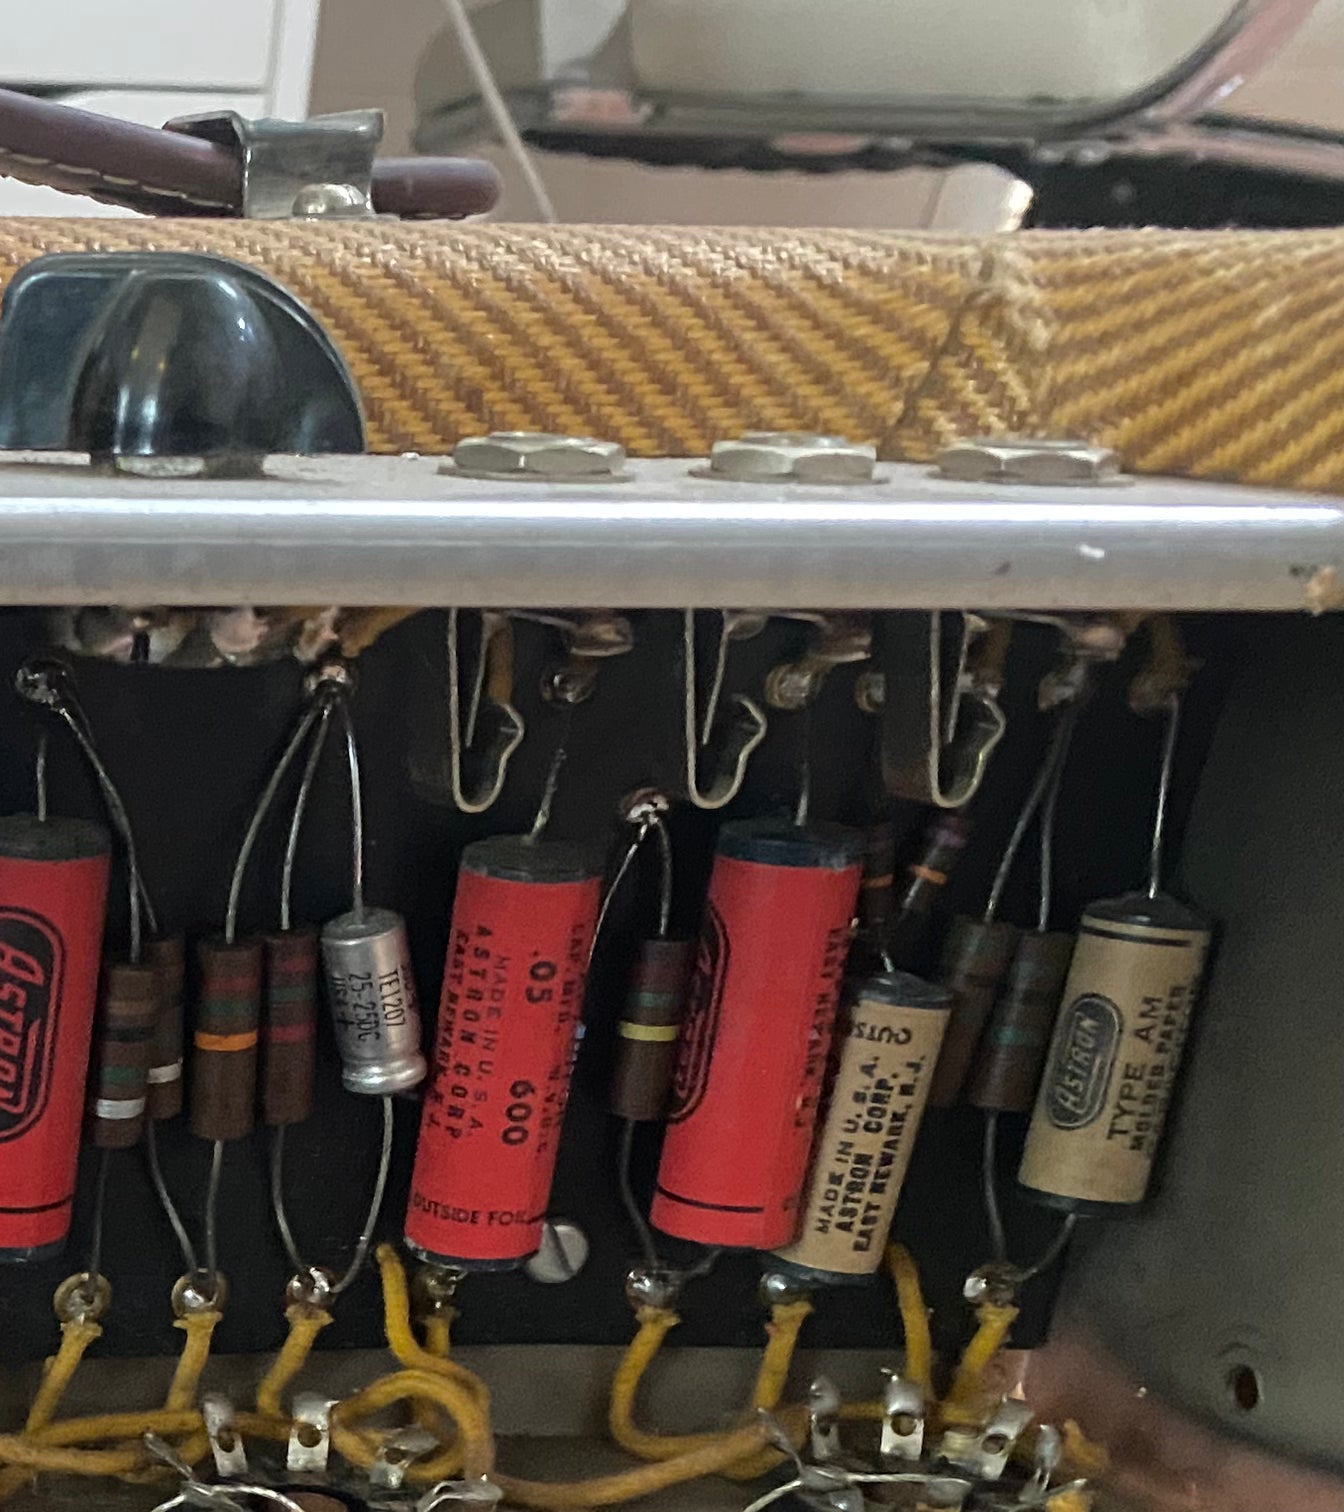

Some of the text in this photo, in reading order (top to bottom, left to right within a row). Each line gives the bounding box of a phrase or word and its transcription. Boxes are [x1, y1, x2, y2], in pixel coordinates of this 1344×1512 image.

[443, 924, 494, 1141] ASTRON CORP
[486, 954, 511, 1021] MADE
[480, 1029, 498, 1052] IN
[499, 948, 560, 1150] .05 600
[1052, 1010, 1101, 1114] ASTRON
[1106, 995, 1163, 1139] TYPE AM
[813, 1171, 845, 1235] MADE
[833, 1140, 855, 1164] IN
[834, 1072, 899, 1233] ASTRON CORP.
[852, 1201, 882, 1252] EAST
